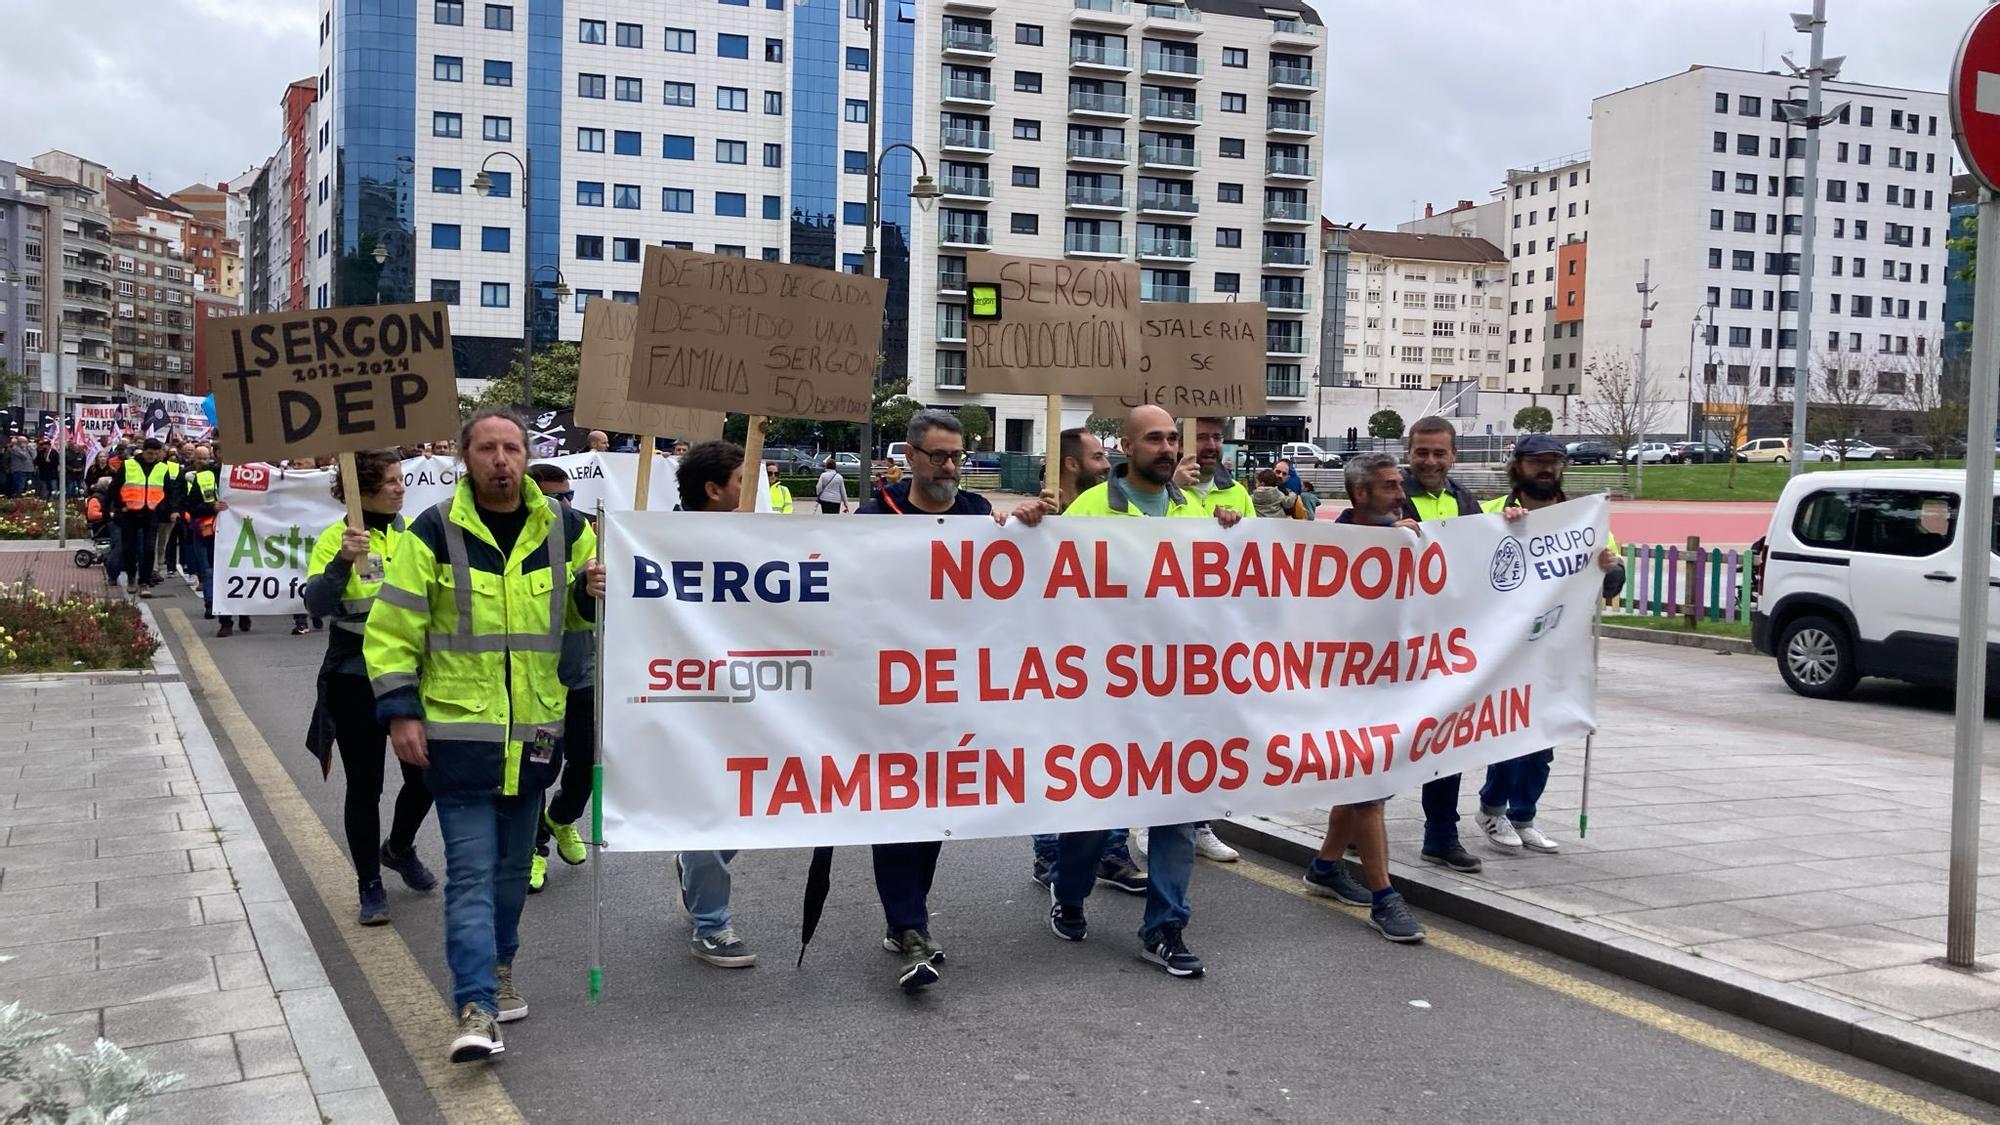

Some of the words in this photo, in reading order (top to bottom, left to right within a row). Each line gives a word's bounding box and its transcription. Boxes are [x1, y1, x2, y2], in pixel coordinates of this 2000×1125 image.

[780, 273, 800, 298] DE
[810, 280, 871, 305] CADA
[650, 296, 794, 341] DESPIDO
[815, 319, 857, 346] UNA
[251, 310, 444, 368] SERGON
[292, 358, 410, 383] 2012-2024
[648, 345, 750, 394] FAMILIA
[765, 345, 876, 376] SERGON
[1190, 353, 1214, 371] SE
[278, 373, 428, 444] DEP
[766, 376, 814, 415] 50
[1120, 382, 1242, 411] IERRA!!!
[81, 420, 101, 430] PARA
[234, 464, 264, 484] top
[418, 470, 436, 486] AL
[567, 461, 604, 480] LERÍA
[1529, 527, 1595, 557] GRUPO
[632, 553, 830, 603] BERGÉ
[930, 540, 1025, 600] NO
[1043, 541, 1128, 599] AL
[1144, 541, 1447, 600] ABANDONO
[1534, 552, 1594, 580] EULEN
[227, 575, 280, 599] 270
[648, 656, 812, 704] sergon
[879, 649, 958, 705] DE
[978, 645, 1088, 701] LAS
[1105, 627, 1477, 698] SUBCONTRATAS
[726, 733, 1025, 817] TAMBIÉN
[1044, 737, 1250, 802] SOMOS
[1263, 723, 1401, 787] SAINT
